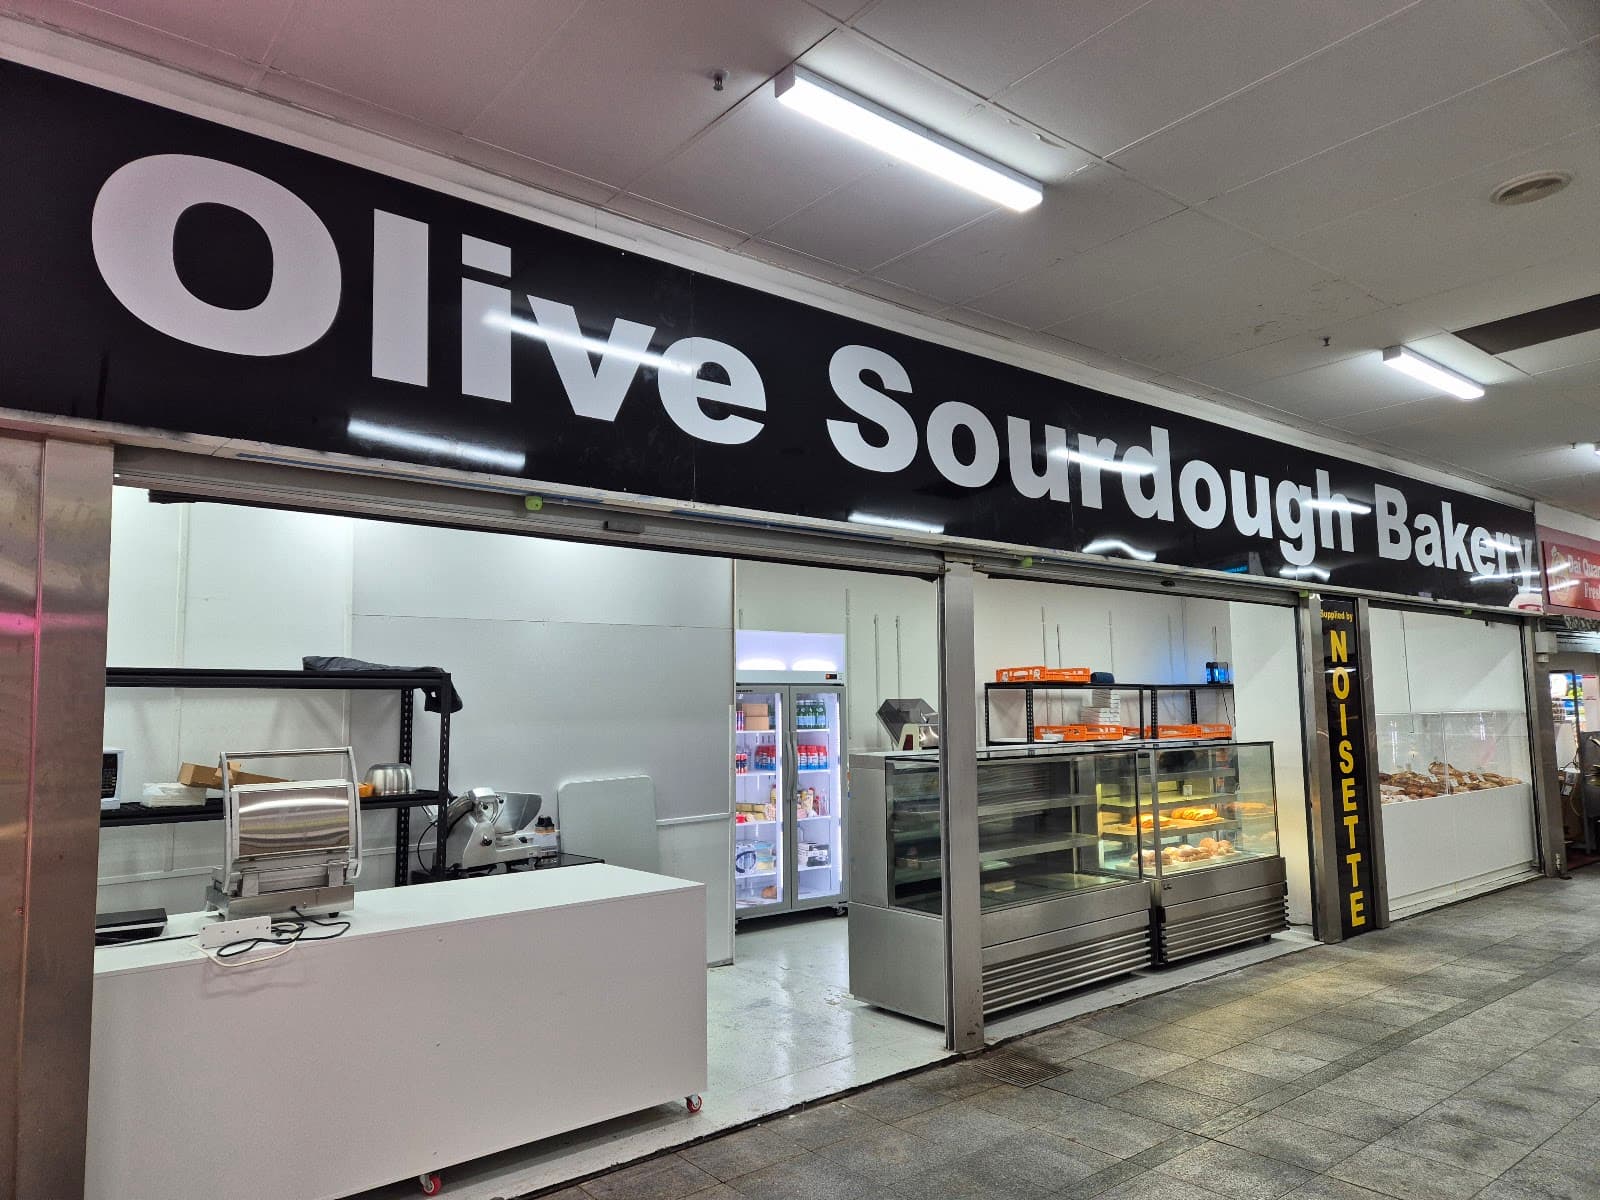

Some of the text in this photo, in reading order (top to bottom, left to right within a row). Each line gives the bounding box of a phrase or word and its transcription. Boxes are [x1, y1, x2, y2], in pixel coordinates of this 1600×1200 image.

[92, 154, 1533, 593] Olive Sourdough Bakery
[1320, 609, 1353, 622] Supplied by
[1329, 629, 1366, 928] NOISETTE
